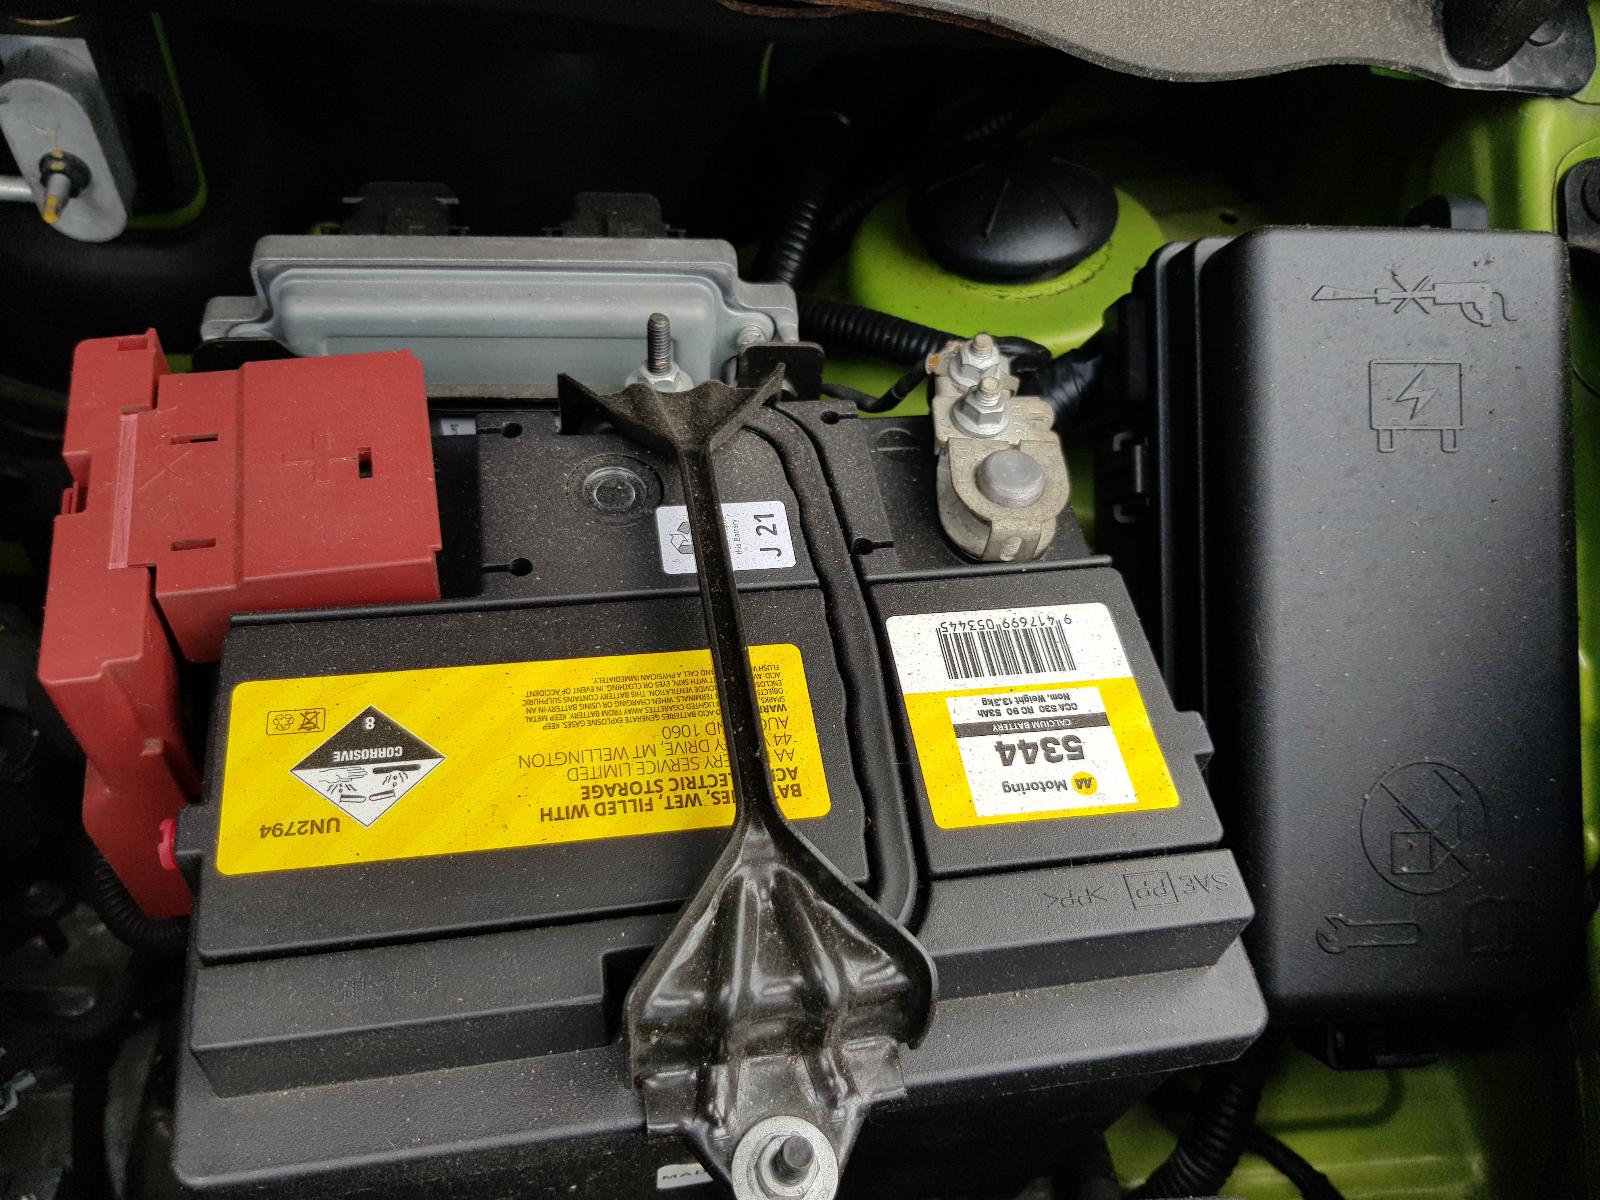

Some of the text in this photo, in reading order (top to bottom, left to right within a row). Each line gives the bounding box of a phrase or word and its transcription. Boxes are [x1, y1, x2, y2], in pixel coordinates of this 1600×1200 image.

[753, 513, 783, 558] J 21
[940, 614, 1072, 632] 9 417699 053445
[981, 692, 1069, 706] Nom. Weight 13.3kg
[624, 713, 660, 722] GENERATE
[661, 710, 696, 719] BATTERIES
[977, 702, 1077, 717] CCA 530 RC 90 53Ah
[365, 716, 377, 730] 8
[661, 723, 698, 739] 1060
[991, 718, 1070, 731] CALCIUM BATTERY
[660, 737, 709, 756] DRIVE,
[772, 731, 792, 746] 44
[332, 745, 403, 762] CORROSIVE
[517, 745, 627, 769] WELLINGTON
[631, 743, 656, 758] MT
[773, 747, 795, 762] AA
[994, 734, 1085, 767] 5344
[566, 762, 631, 781] LIMITED
[634, 755, 699, 775] SERVICE
[580, 778, 664, 800] STORAGE
[1001, 779, 1067, 795] Motoring
[593, 796, 653, 816] FILLED
[658, 790, 702, 810] WET,
[539, 803, 588, 822] WITH
[259, 817, 341, 839] UN2794
